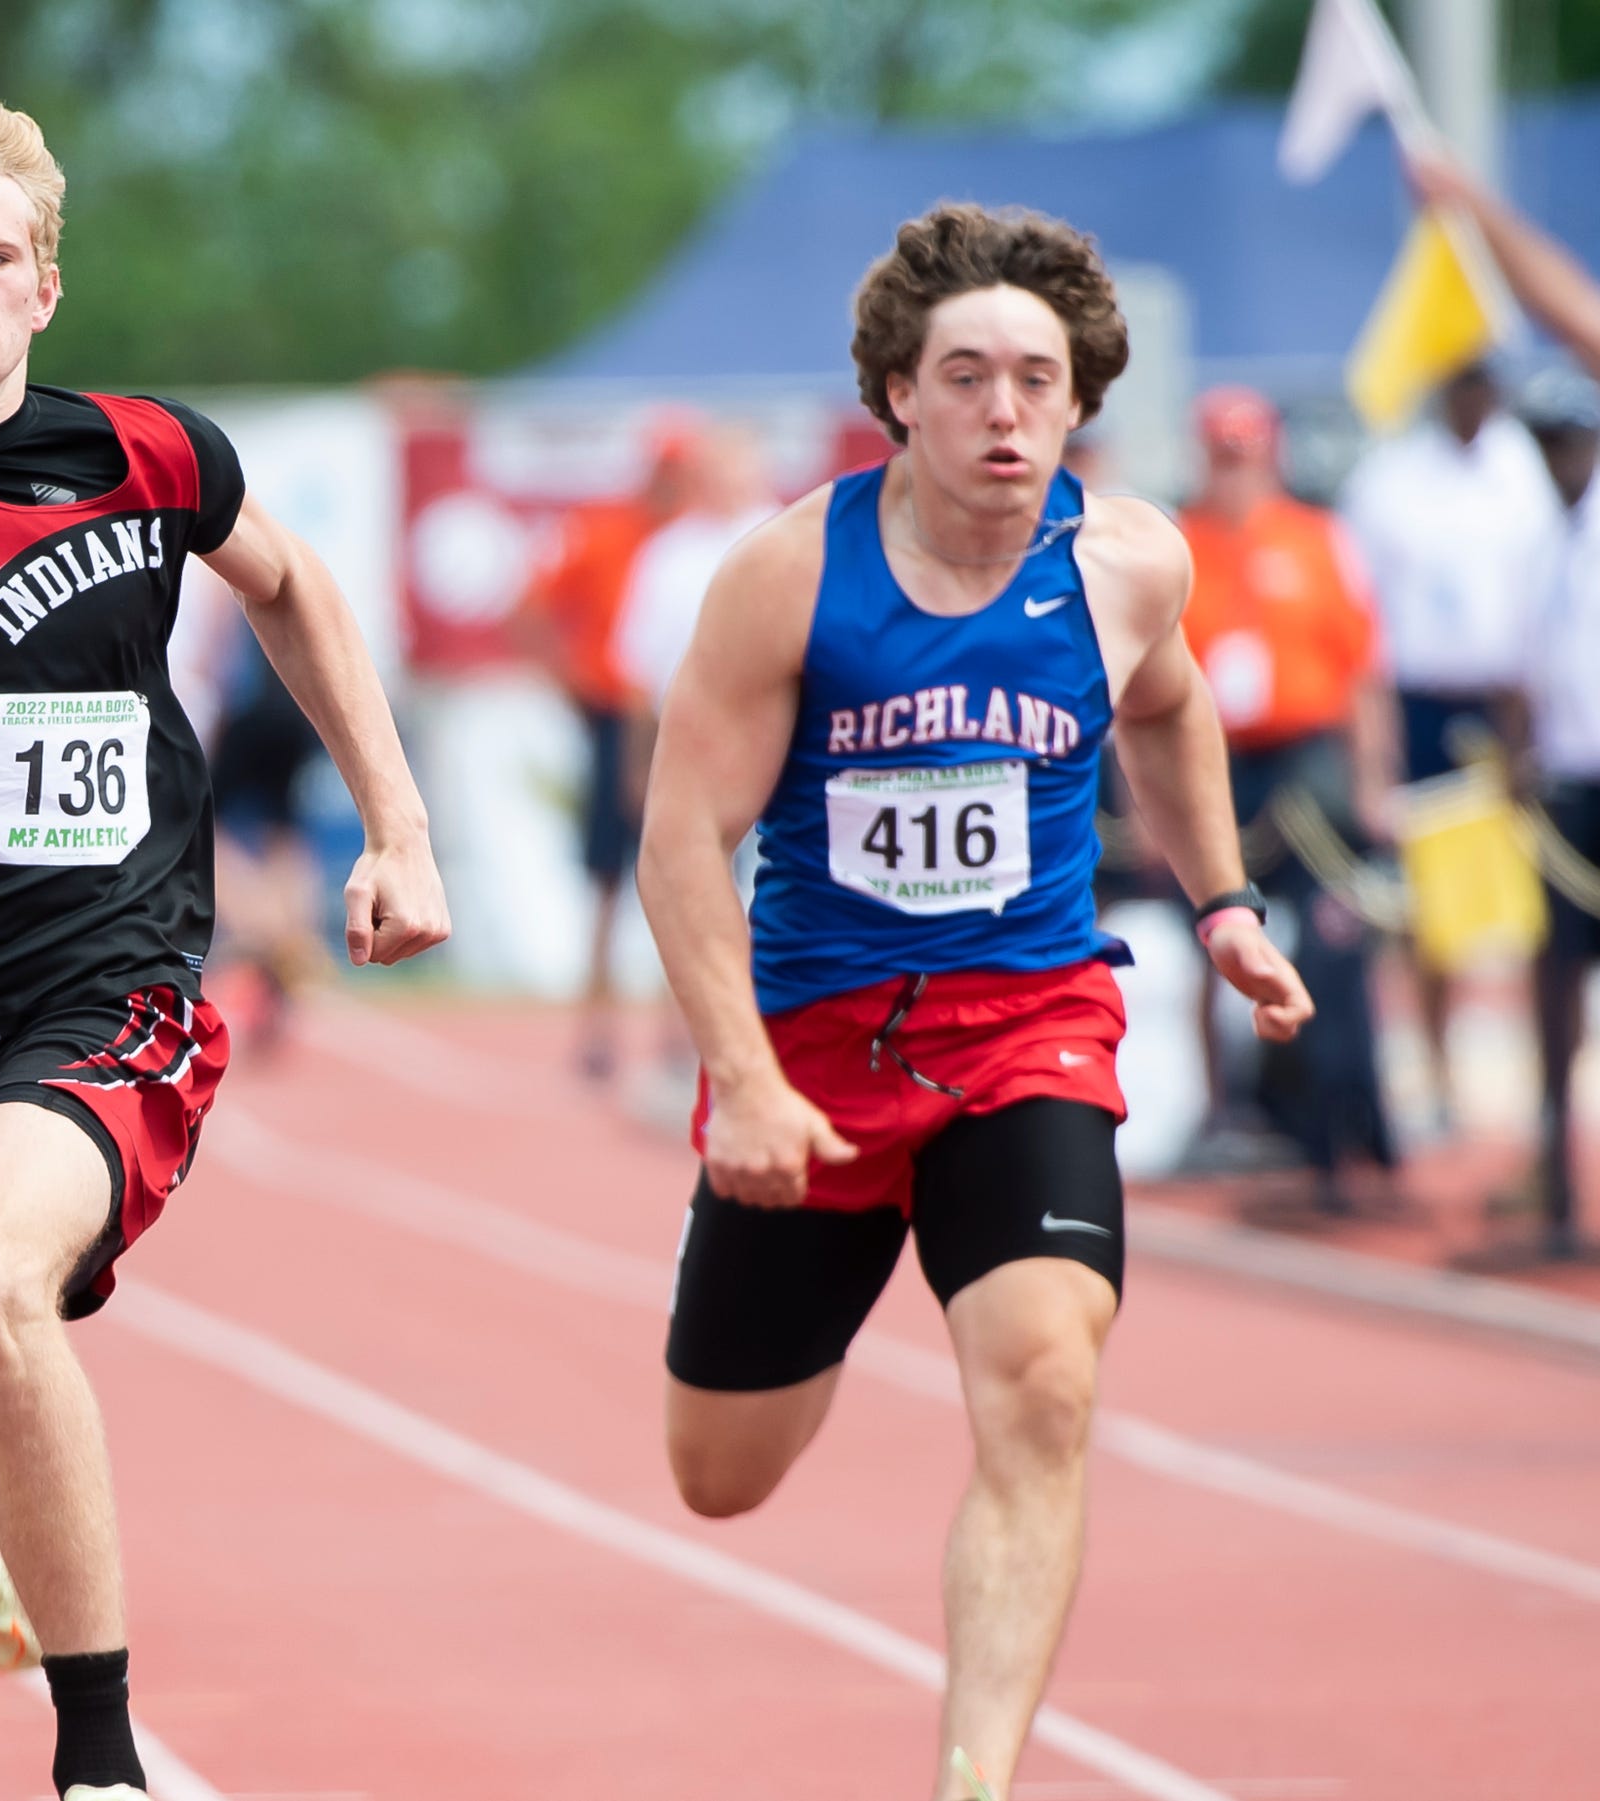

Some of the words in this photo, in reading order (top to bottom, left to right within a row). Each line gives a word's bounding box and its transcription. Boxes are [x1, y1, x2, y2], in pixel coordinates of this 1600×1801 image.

[6, 701, 46, 715] 2022
[51, 701, 83, 714] PIAA
[87, 700, 102, 713] AA
[106, 699, 135, 712] BOYS
[2, 716, 35, 725] TRACK
[47, 715, 72, 725] FIELD
[828, 684, 1080, 758] RICHLAND
[15, 738, 126, 816] 136
[8, 827, 40, 848] MF
[43, 826, 128, 847] ATHLETIC
[861, 802, 997, 869] 416
[896, 877, 995, 898] ATHLETIC
